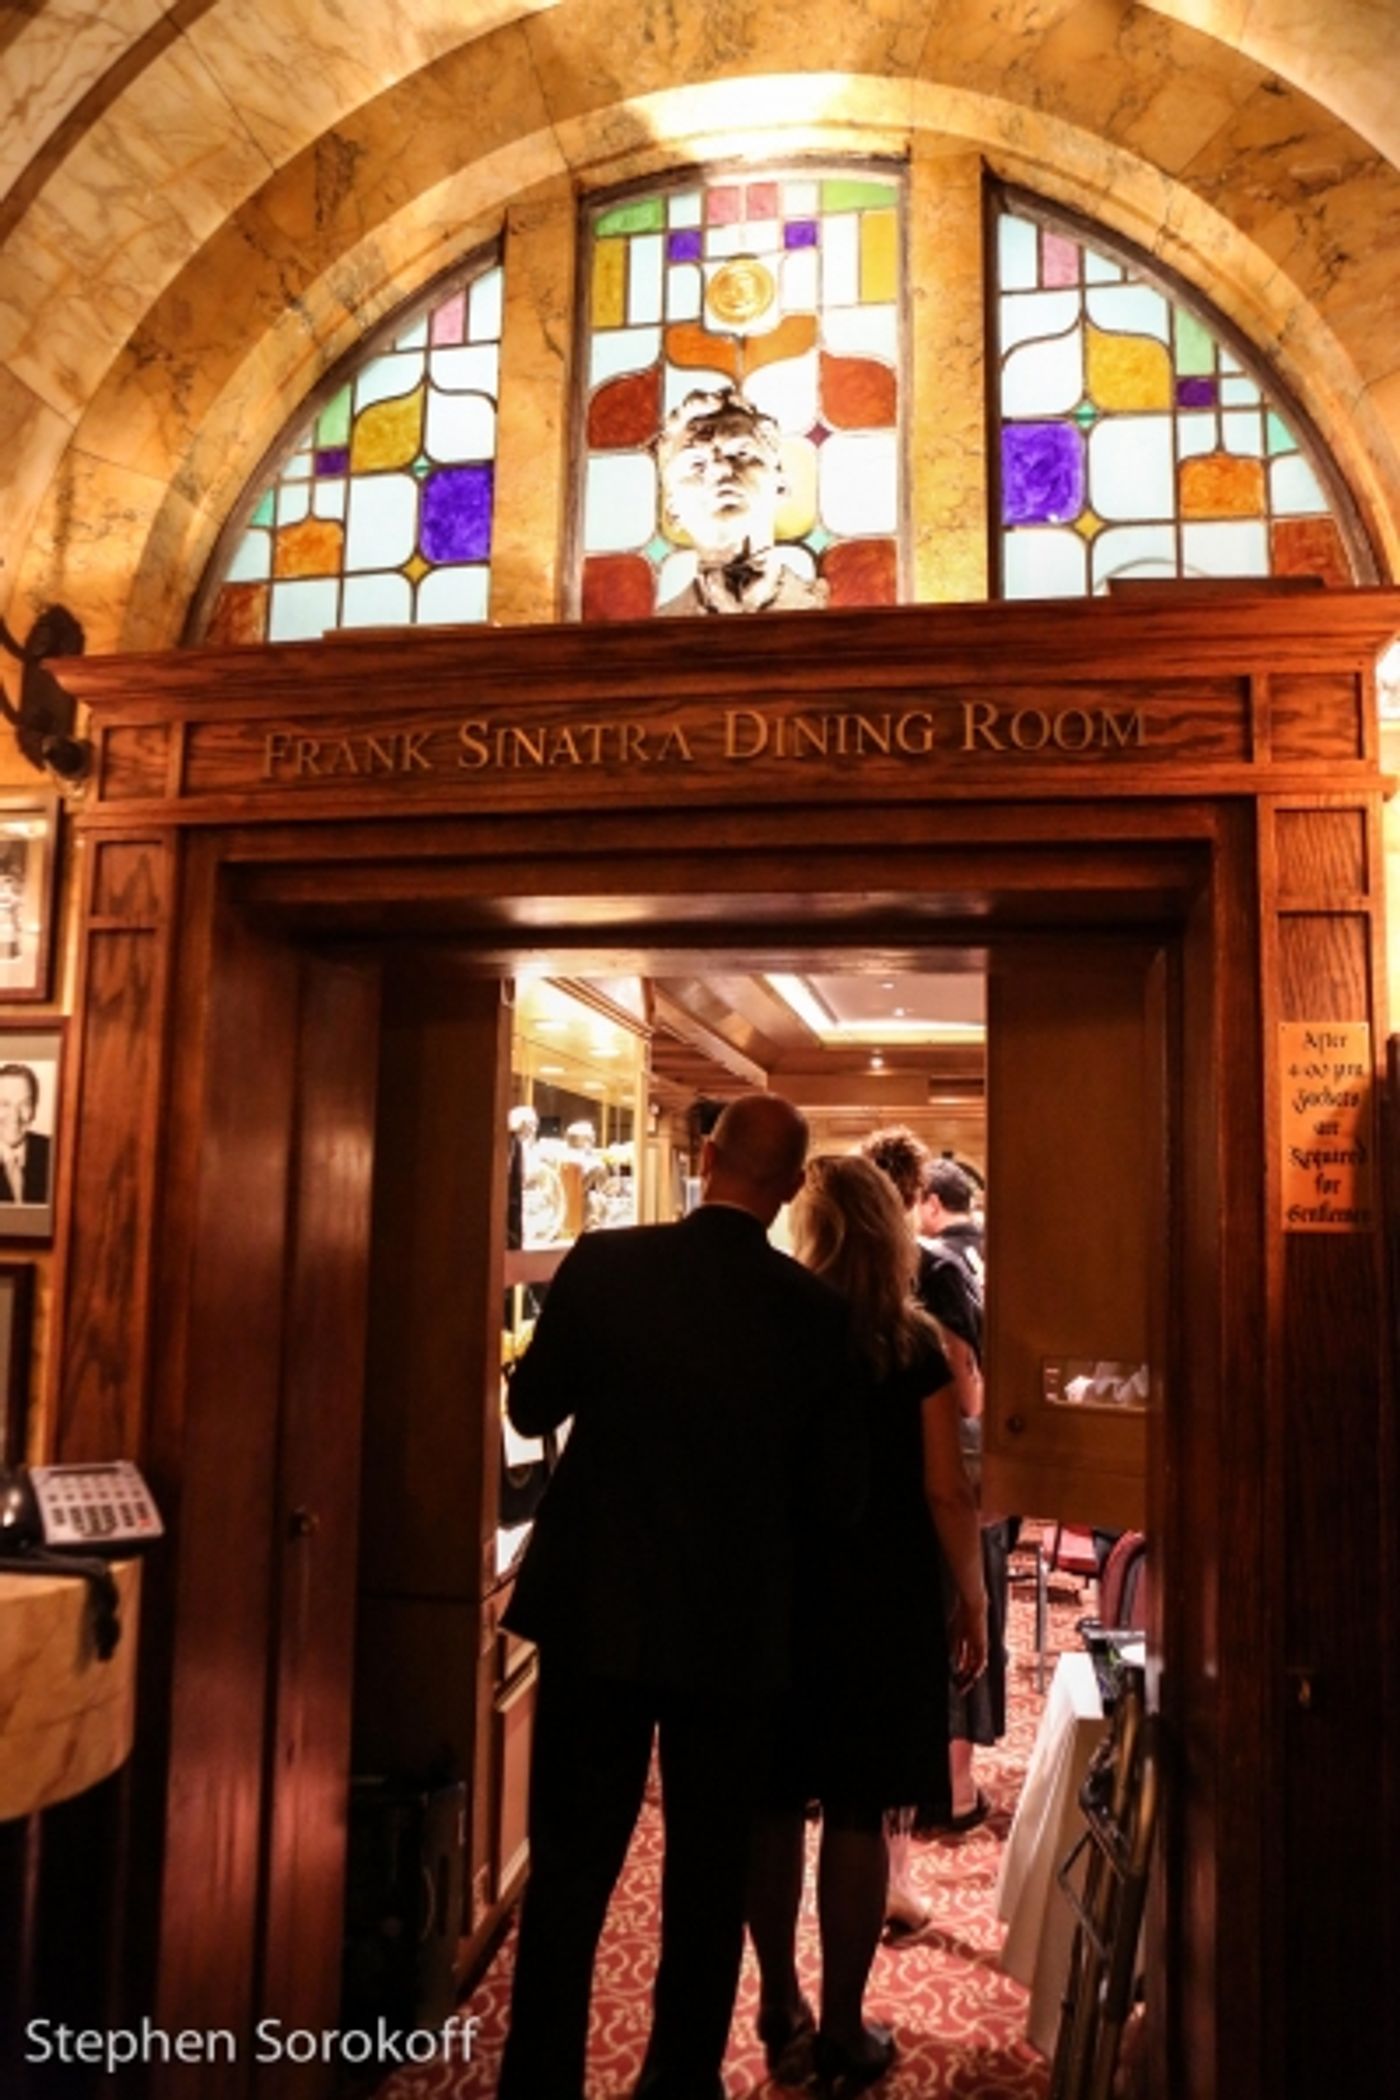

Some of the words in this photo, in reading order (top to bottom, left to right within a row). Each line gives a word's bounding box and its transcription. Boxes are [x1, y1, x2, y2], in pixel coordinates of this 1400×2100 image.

[262, 731, 433, 779] FRANK
[458, 720, 695, 769] SINATRA
[723, 709, 935, 759] DINING
[961, 701, 1149, 752] ROOM
